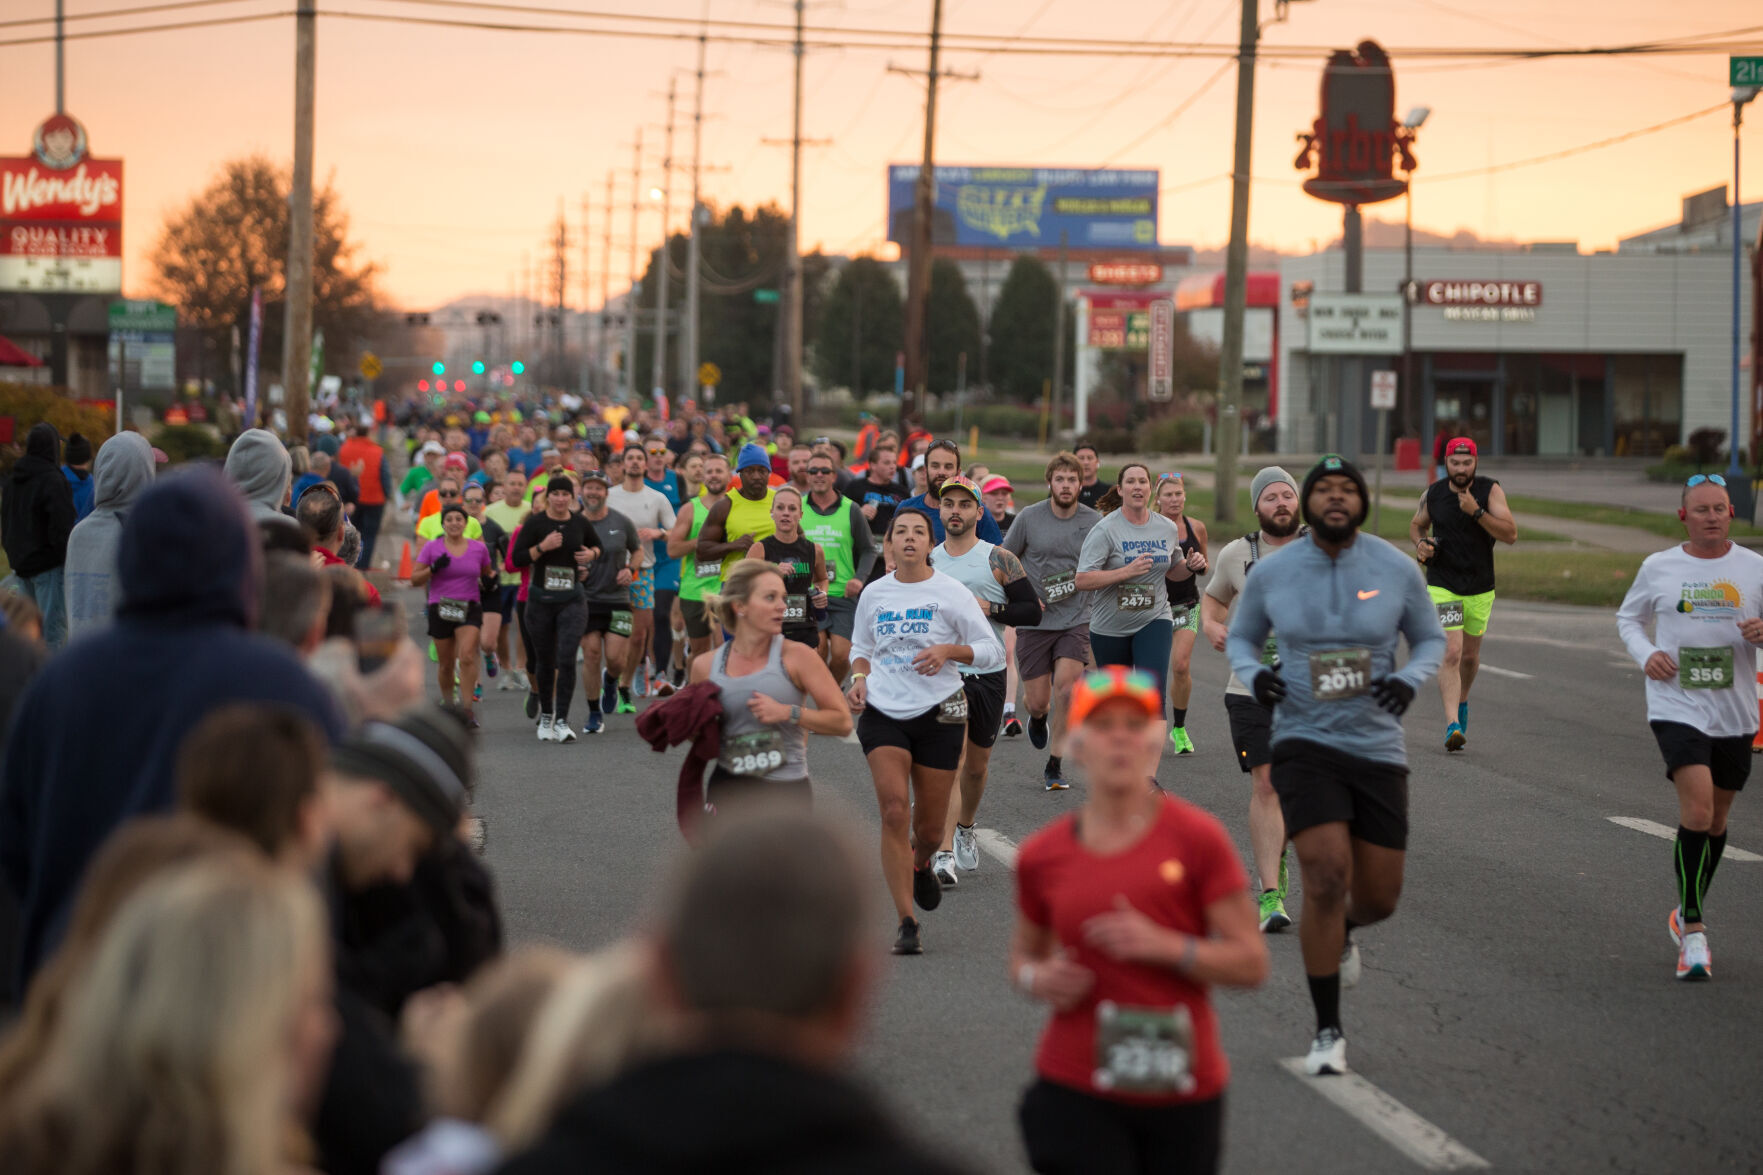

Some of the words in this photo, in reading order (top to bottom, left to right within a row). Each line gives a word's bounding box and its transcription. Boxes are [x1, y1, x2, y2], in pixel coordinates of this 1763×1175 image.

[3, 164, 118, 216] Wendy's
[11, 226, 108, 244] QUALITY
[1428, 282, 1538, 304] CHIPOTLE
[1122, 540, 1168, 552] ROCKVALE
[547, 577, 572, 588] 2872
[1048, 582, 1075, 598] 2510
[1121, 596, 1152, 607] 2475
[1682, 589, 1724, 600] FLORIDA
[877, 611, 904, 623] WILL
[905, 607, 934, 621] RUN
[1440, 612, 1463, 624] 2001
[877, 623, 896, 637] FOR
[900, 621, 930, 634] CATS
[1318, 670, 1364, 691] 2011
[1689, 667, 1724, 682] 356
[732, 749, 782, 775] 2869
